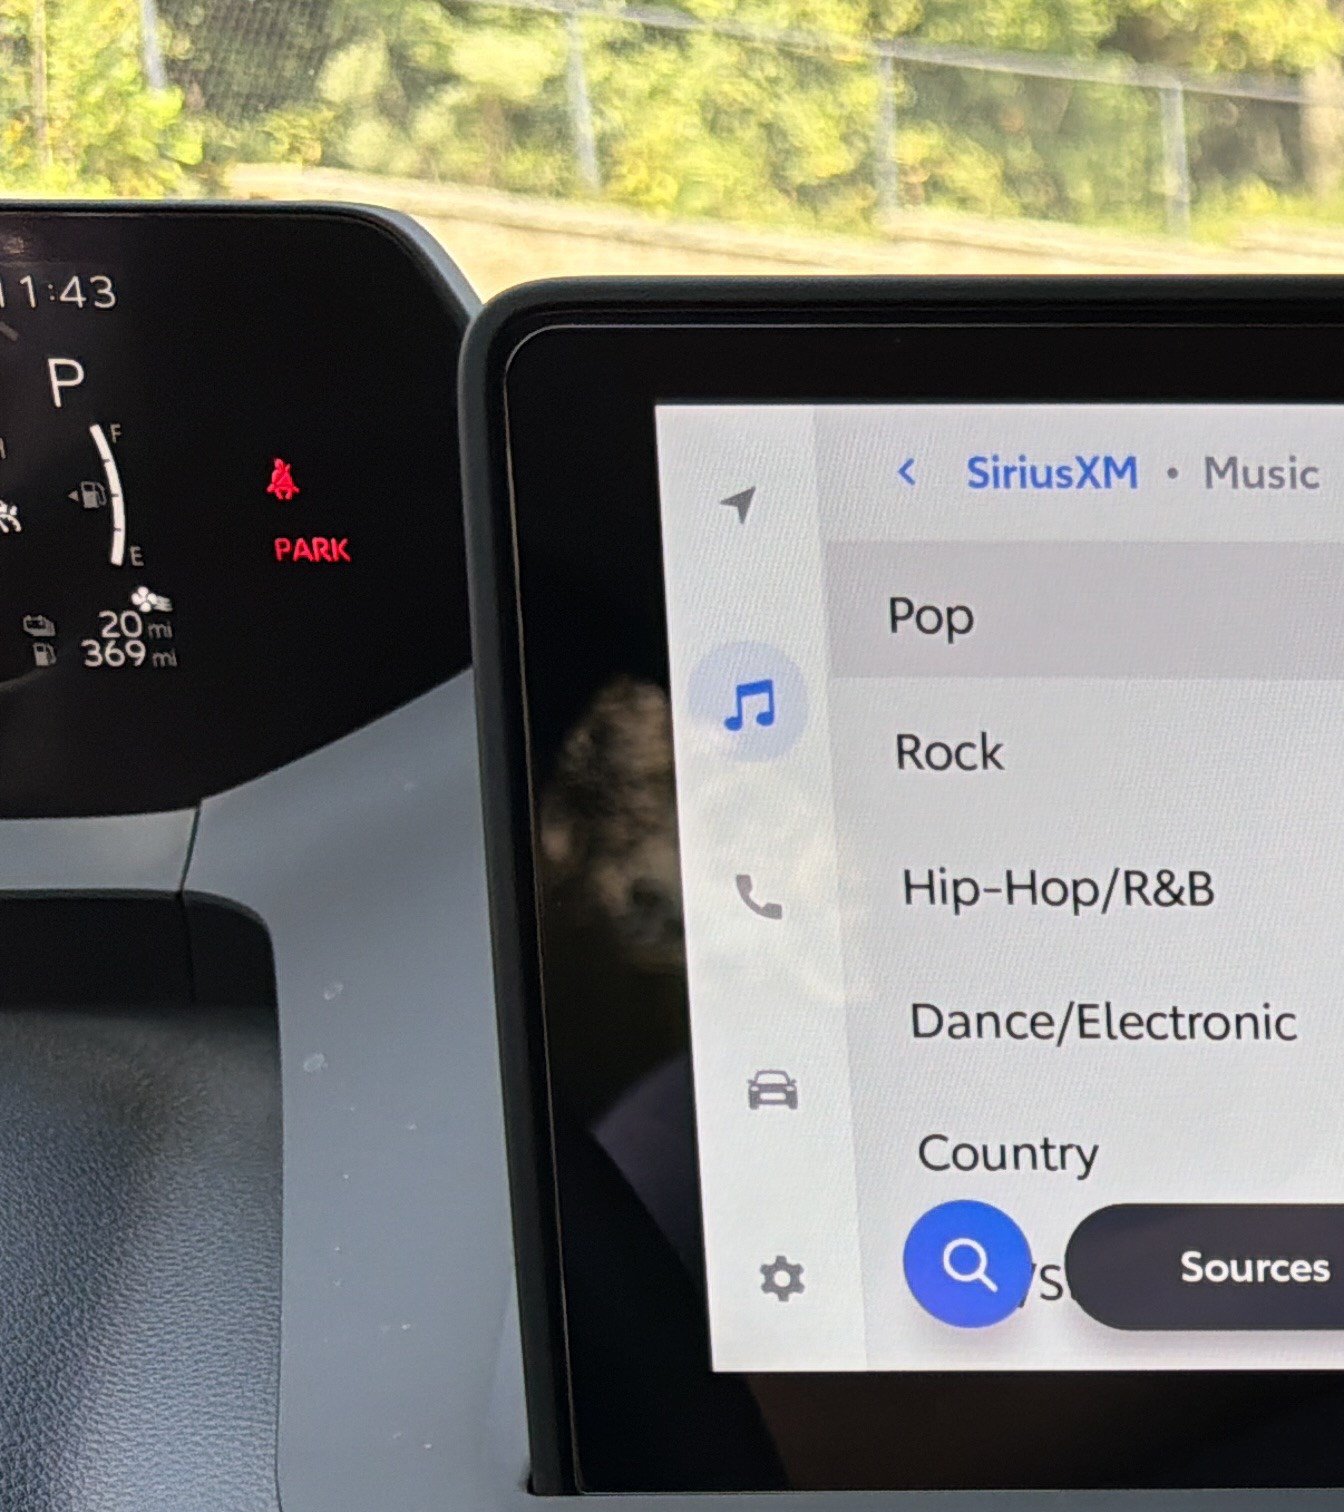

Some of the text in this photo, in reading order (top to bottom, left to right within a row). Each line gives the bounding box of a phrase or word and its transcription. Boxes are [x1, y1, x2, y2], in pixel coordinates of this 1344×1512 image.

[48, 358, 85, 408] P
[110, 423, 122, 443] F
[966, 455, 1320, 490] SiriusXM Music
[130, 546, 144, 566] E
[274, 537, 351, 562] PARK
[99, 610, 172, 639] 20 mi
[888, 597, 974, 642] Pop
[81, 639, 177, 667] 369 mi
[896, 732, 1004, 771] Rock
[904, 867, 1215, 914] Hip-Hop/R&B
[911, 1001, 1298, 1047] Dance/Electronic
[918, 1134, 1098, 1179] Country
[1180, 1250, 1331, 1284] Sources
